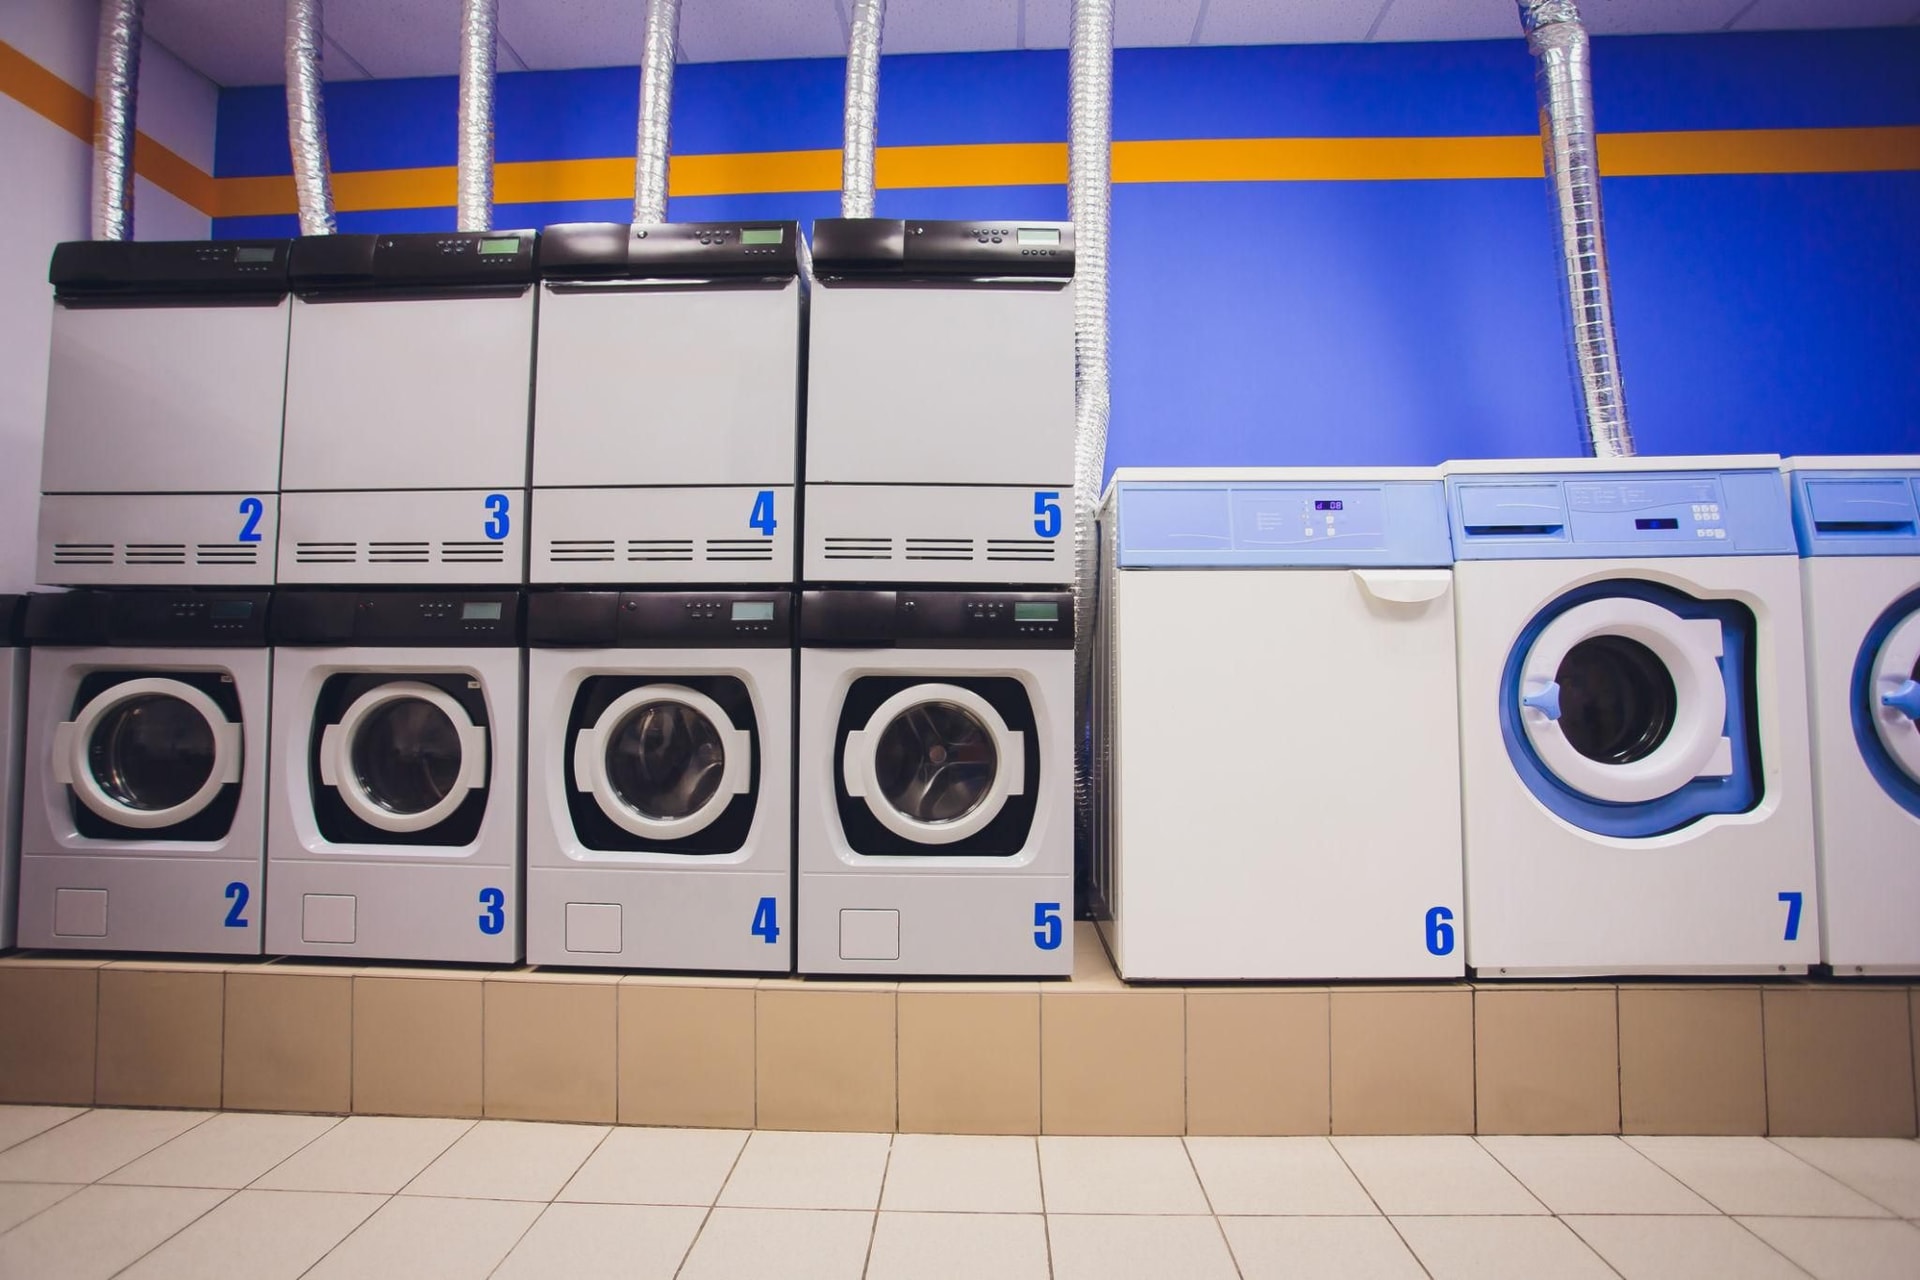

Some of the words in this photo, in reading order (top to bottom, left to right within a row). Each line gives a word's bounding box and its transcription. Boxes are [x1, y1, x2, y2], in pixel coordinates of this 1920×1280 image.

[239, 497, 263, 542] 2
[484, 494, 510, 540] 3
[750, 491, 776, 535] 4
[1034, 493, 1062, 538] 5
[224, 882, 249, 928] 2
[479, 887, 505, 935] 3
[751, 897, 780, 944] 4
[1034, 902, 1062, 950] 5
[1778, 892, 1803, 941] 7
[1425, 906, 1454, 956] 6
